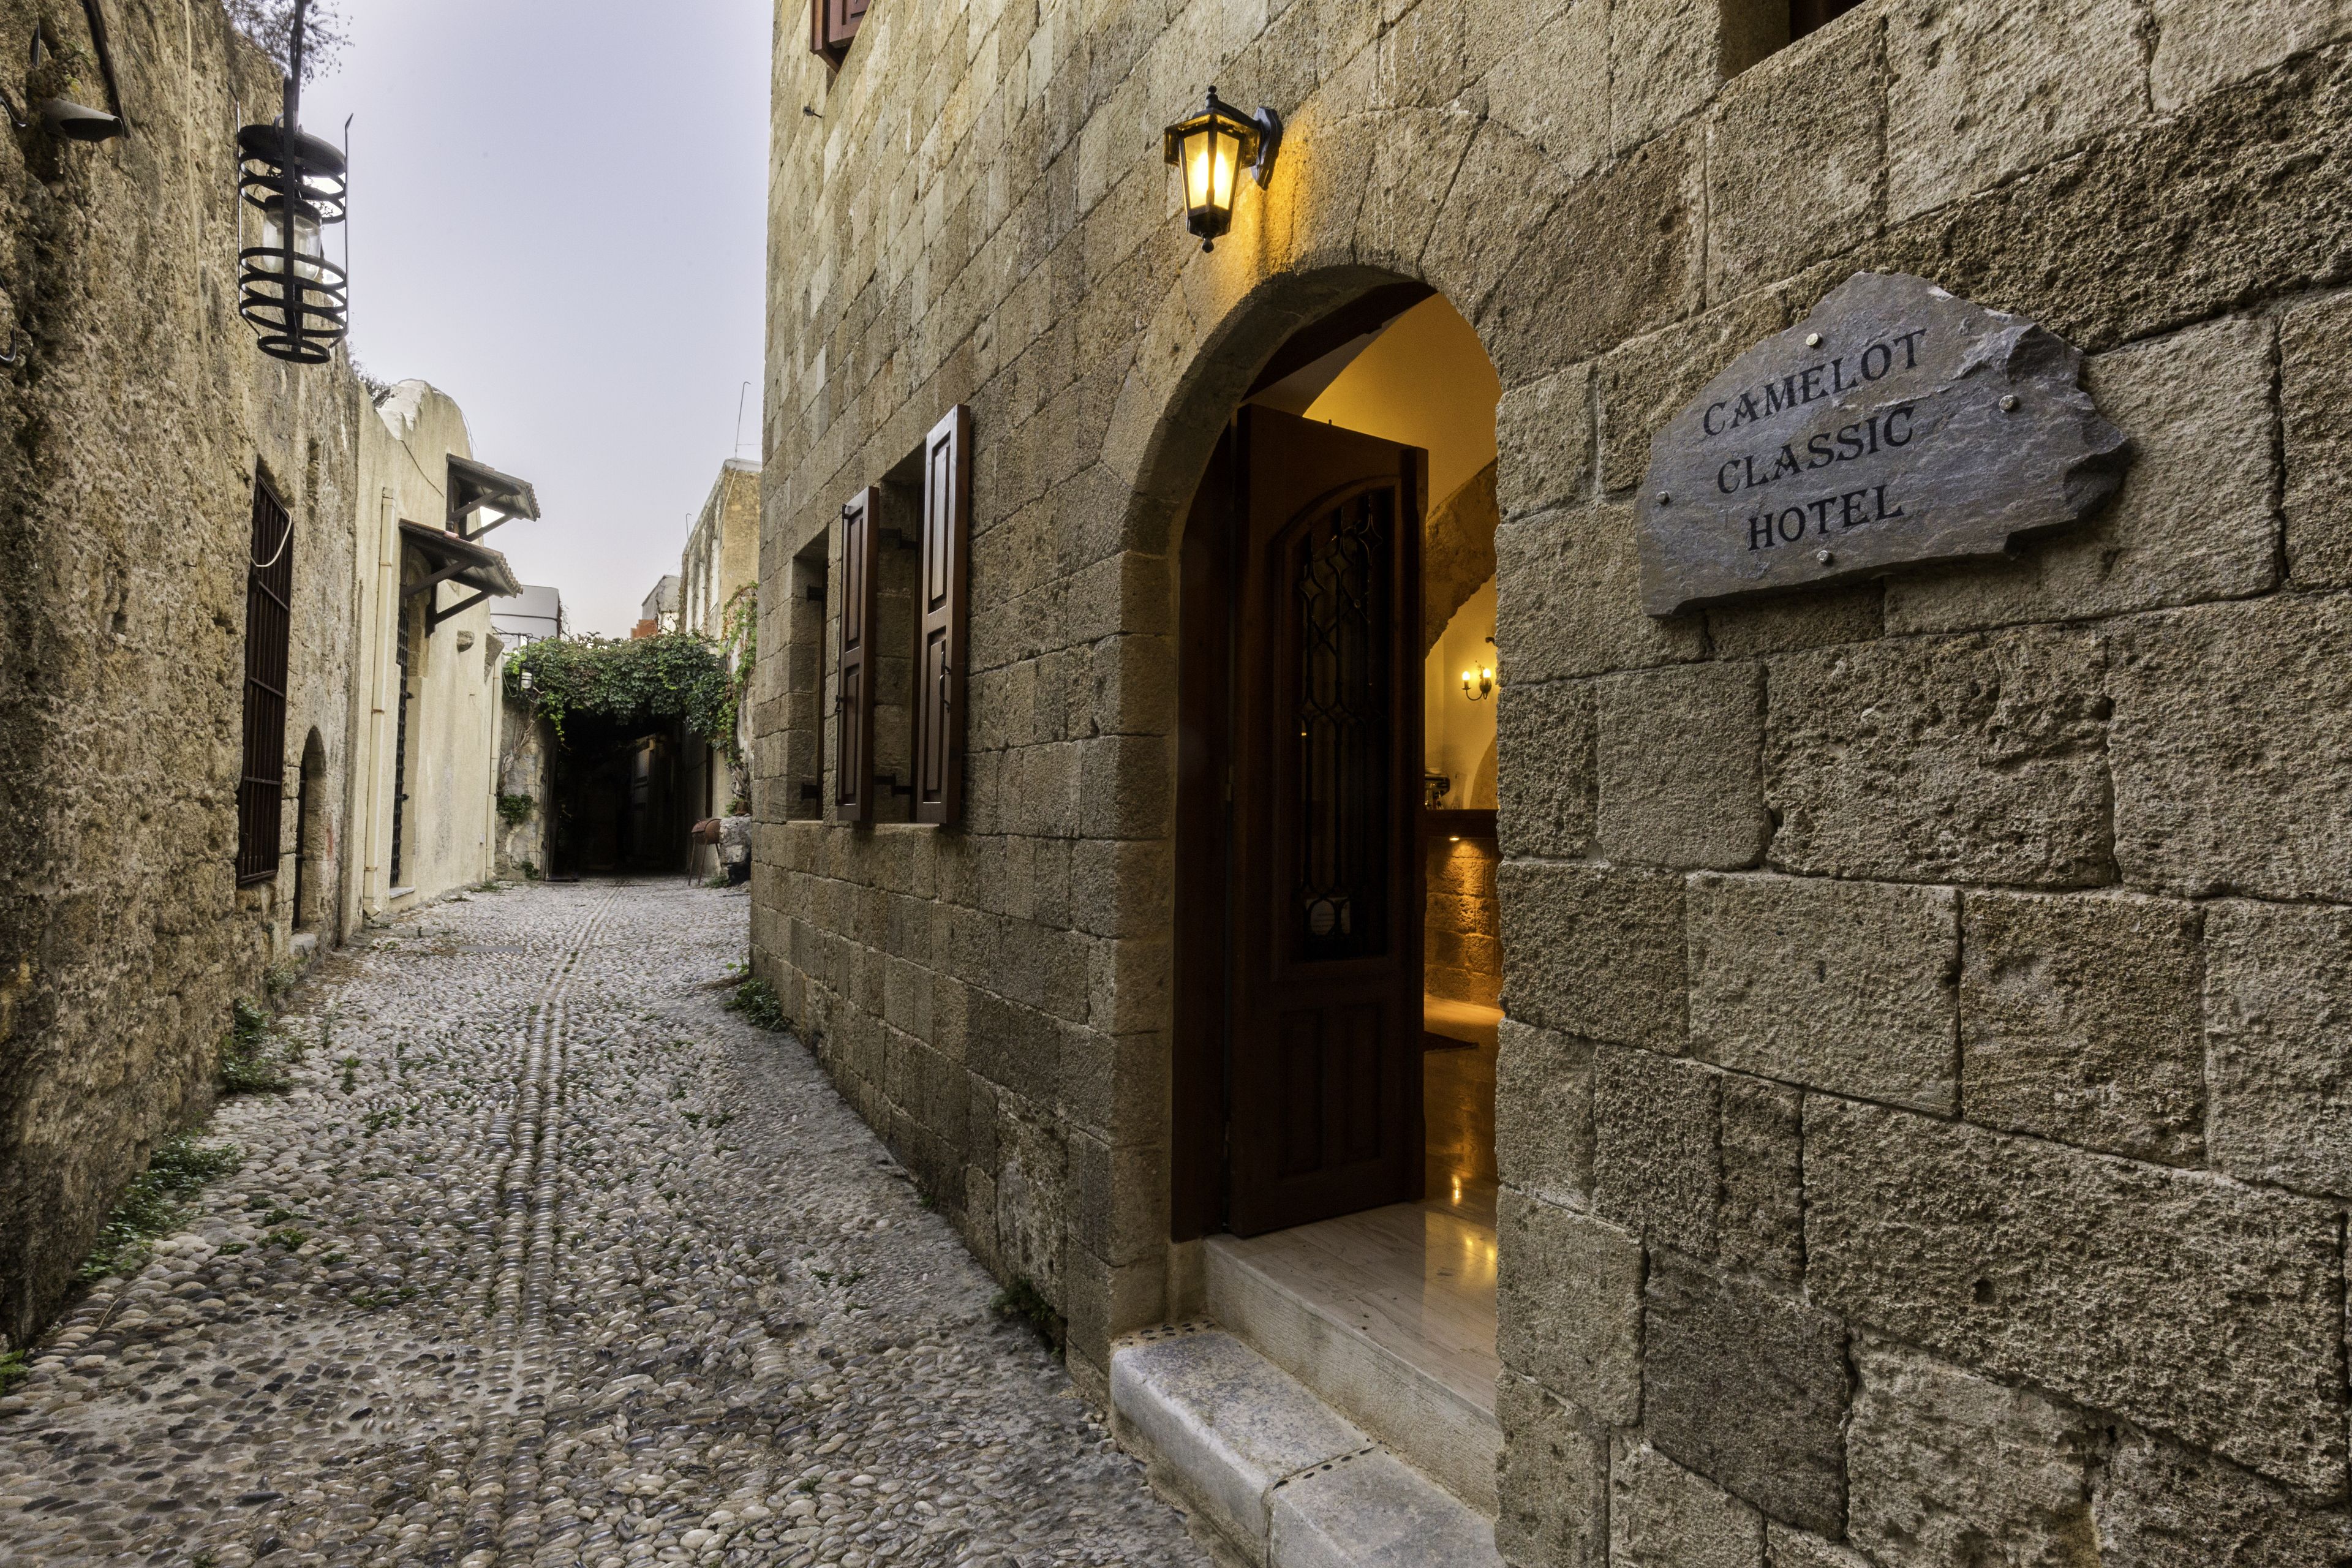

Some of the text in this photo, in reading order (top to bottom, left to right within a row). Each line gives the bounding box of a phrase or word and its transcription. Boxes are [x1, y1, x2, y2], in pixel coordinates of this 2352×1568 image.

[1703, 328, 1927, 436] CAMELOT
[1717, 406, 1915, 494] CLASSIC
[1747, 484, 1904, 551] HOTEL
